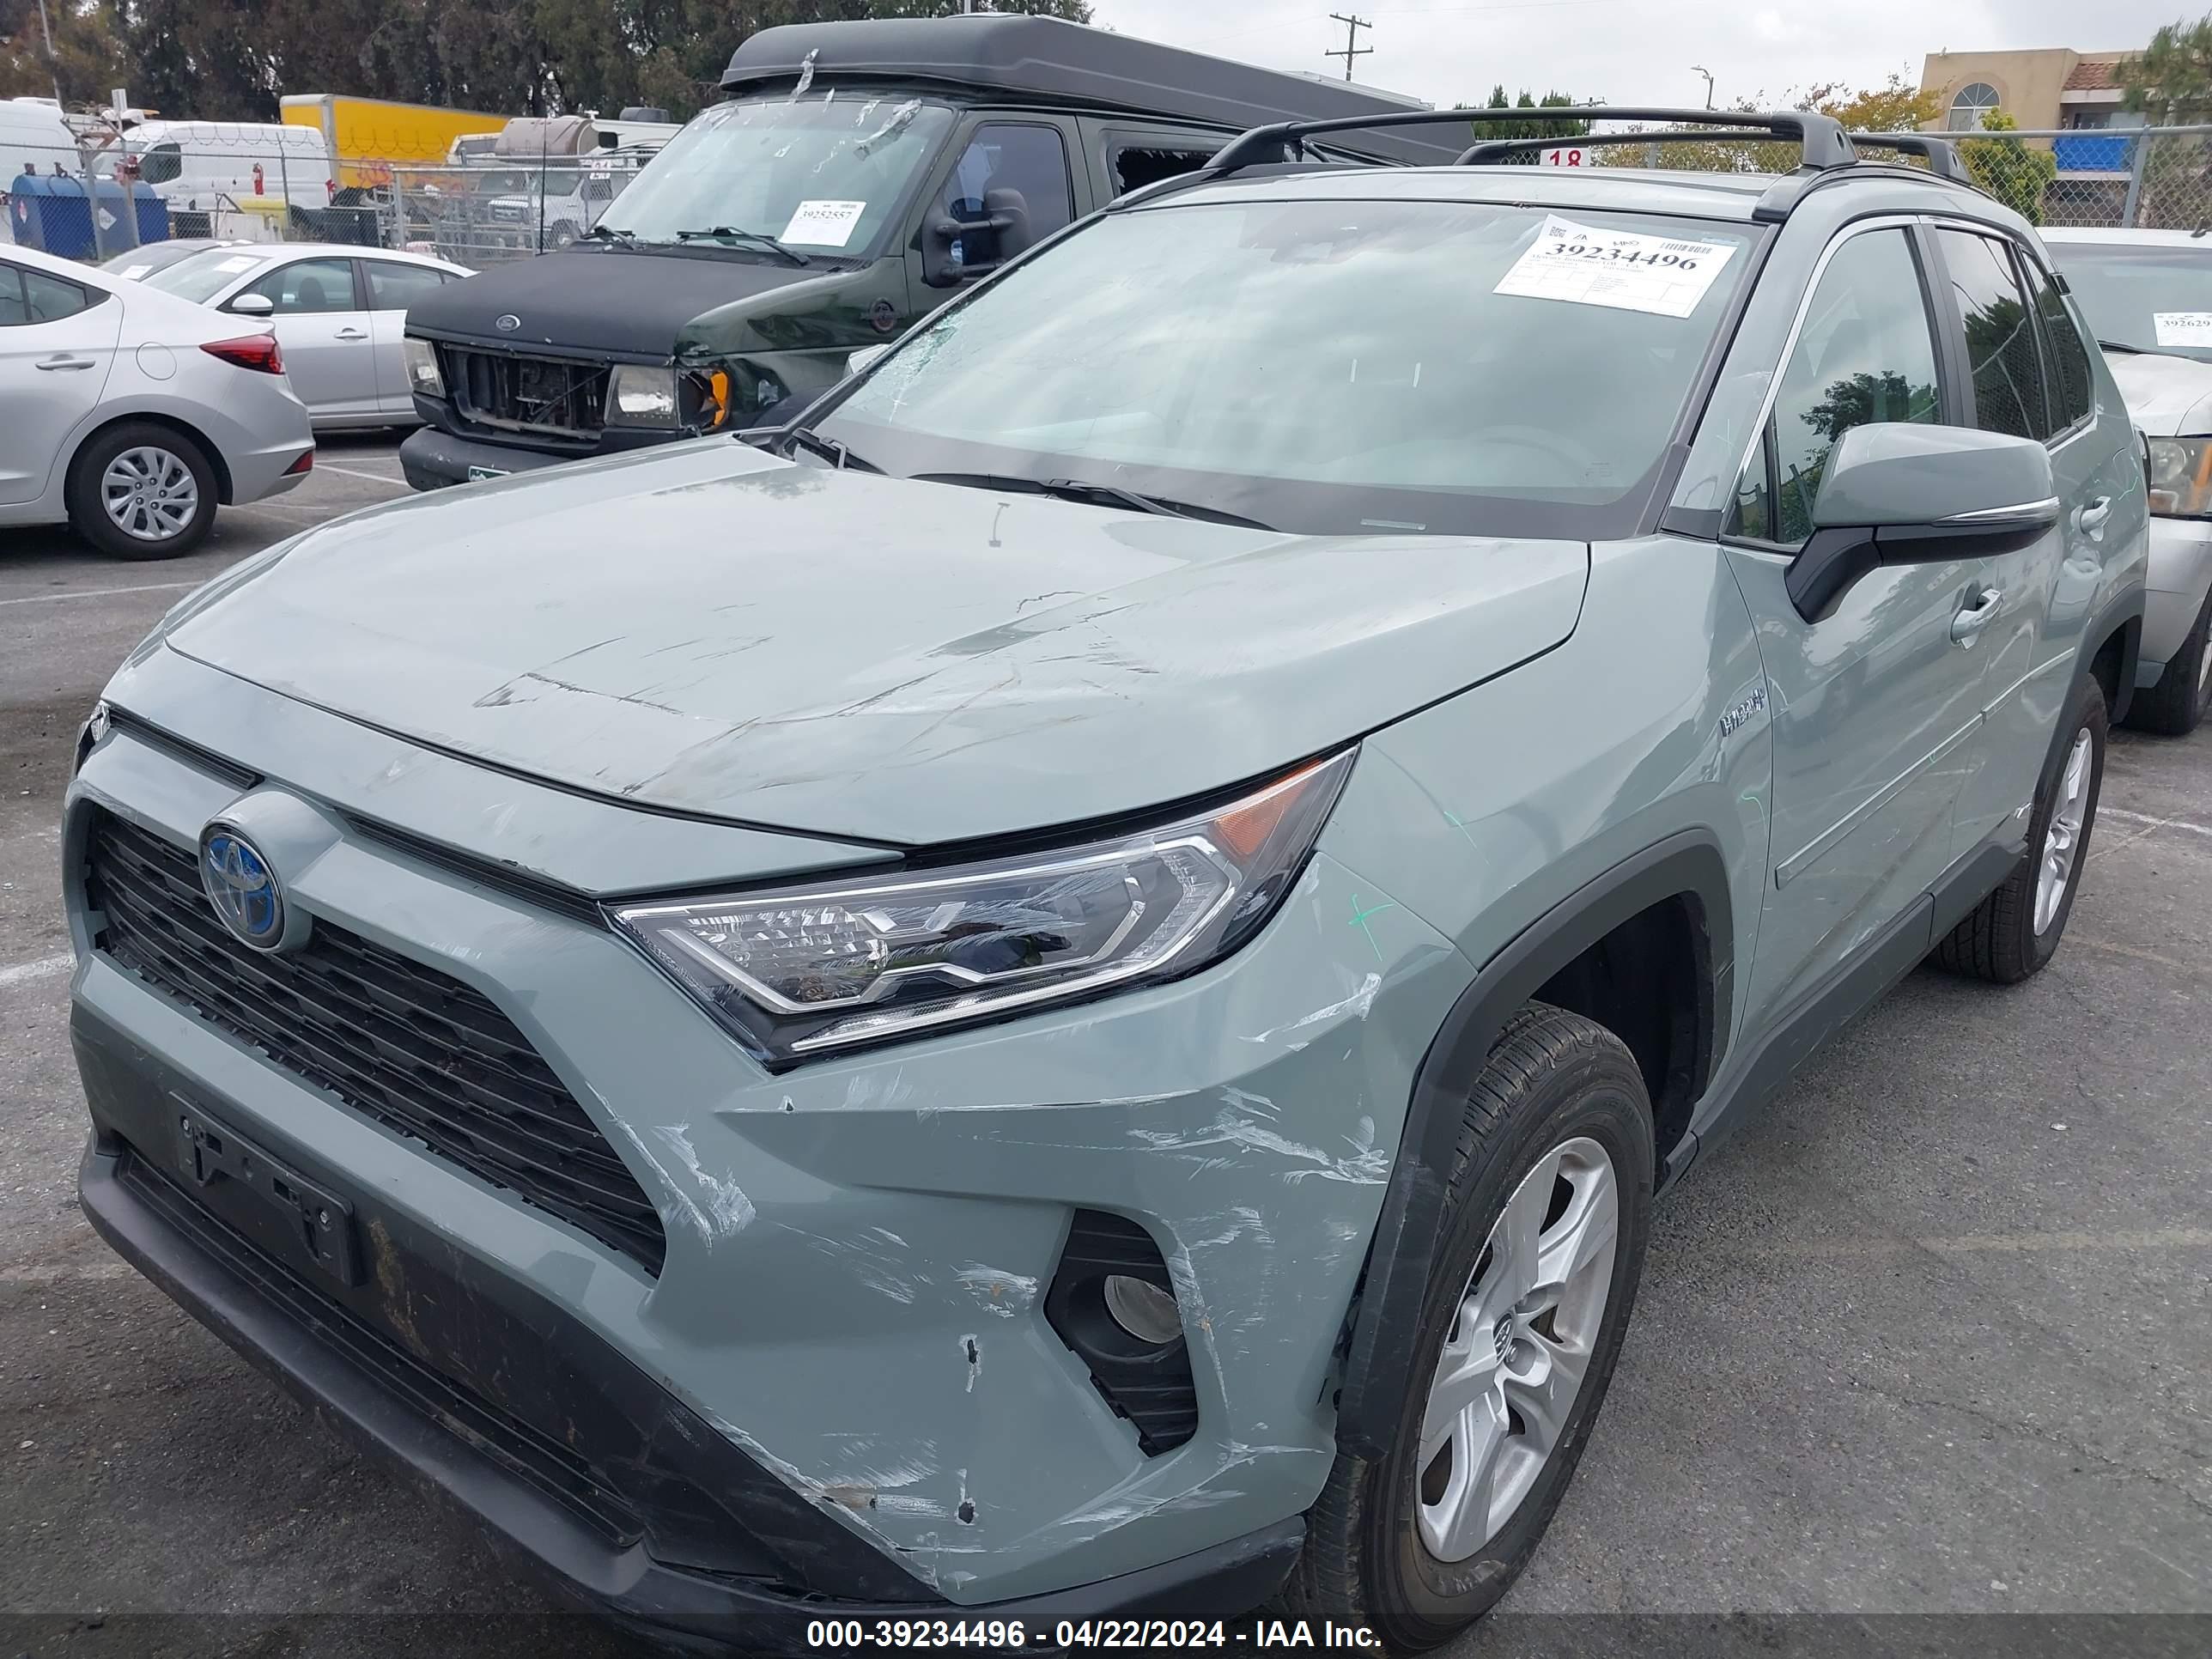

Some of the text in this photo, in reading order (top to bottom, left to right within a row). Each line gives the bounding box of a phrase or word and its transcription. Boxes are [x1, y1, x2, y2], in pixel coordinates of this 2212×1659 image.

[1549, 149, 1582, 167] 18
[803, 210, 853, 220] 39252557
[1545, 242, 1702, 270] 39234496
